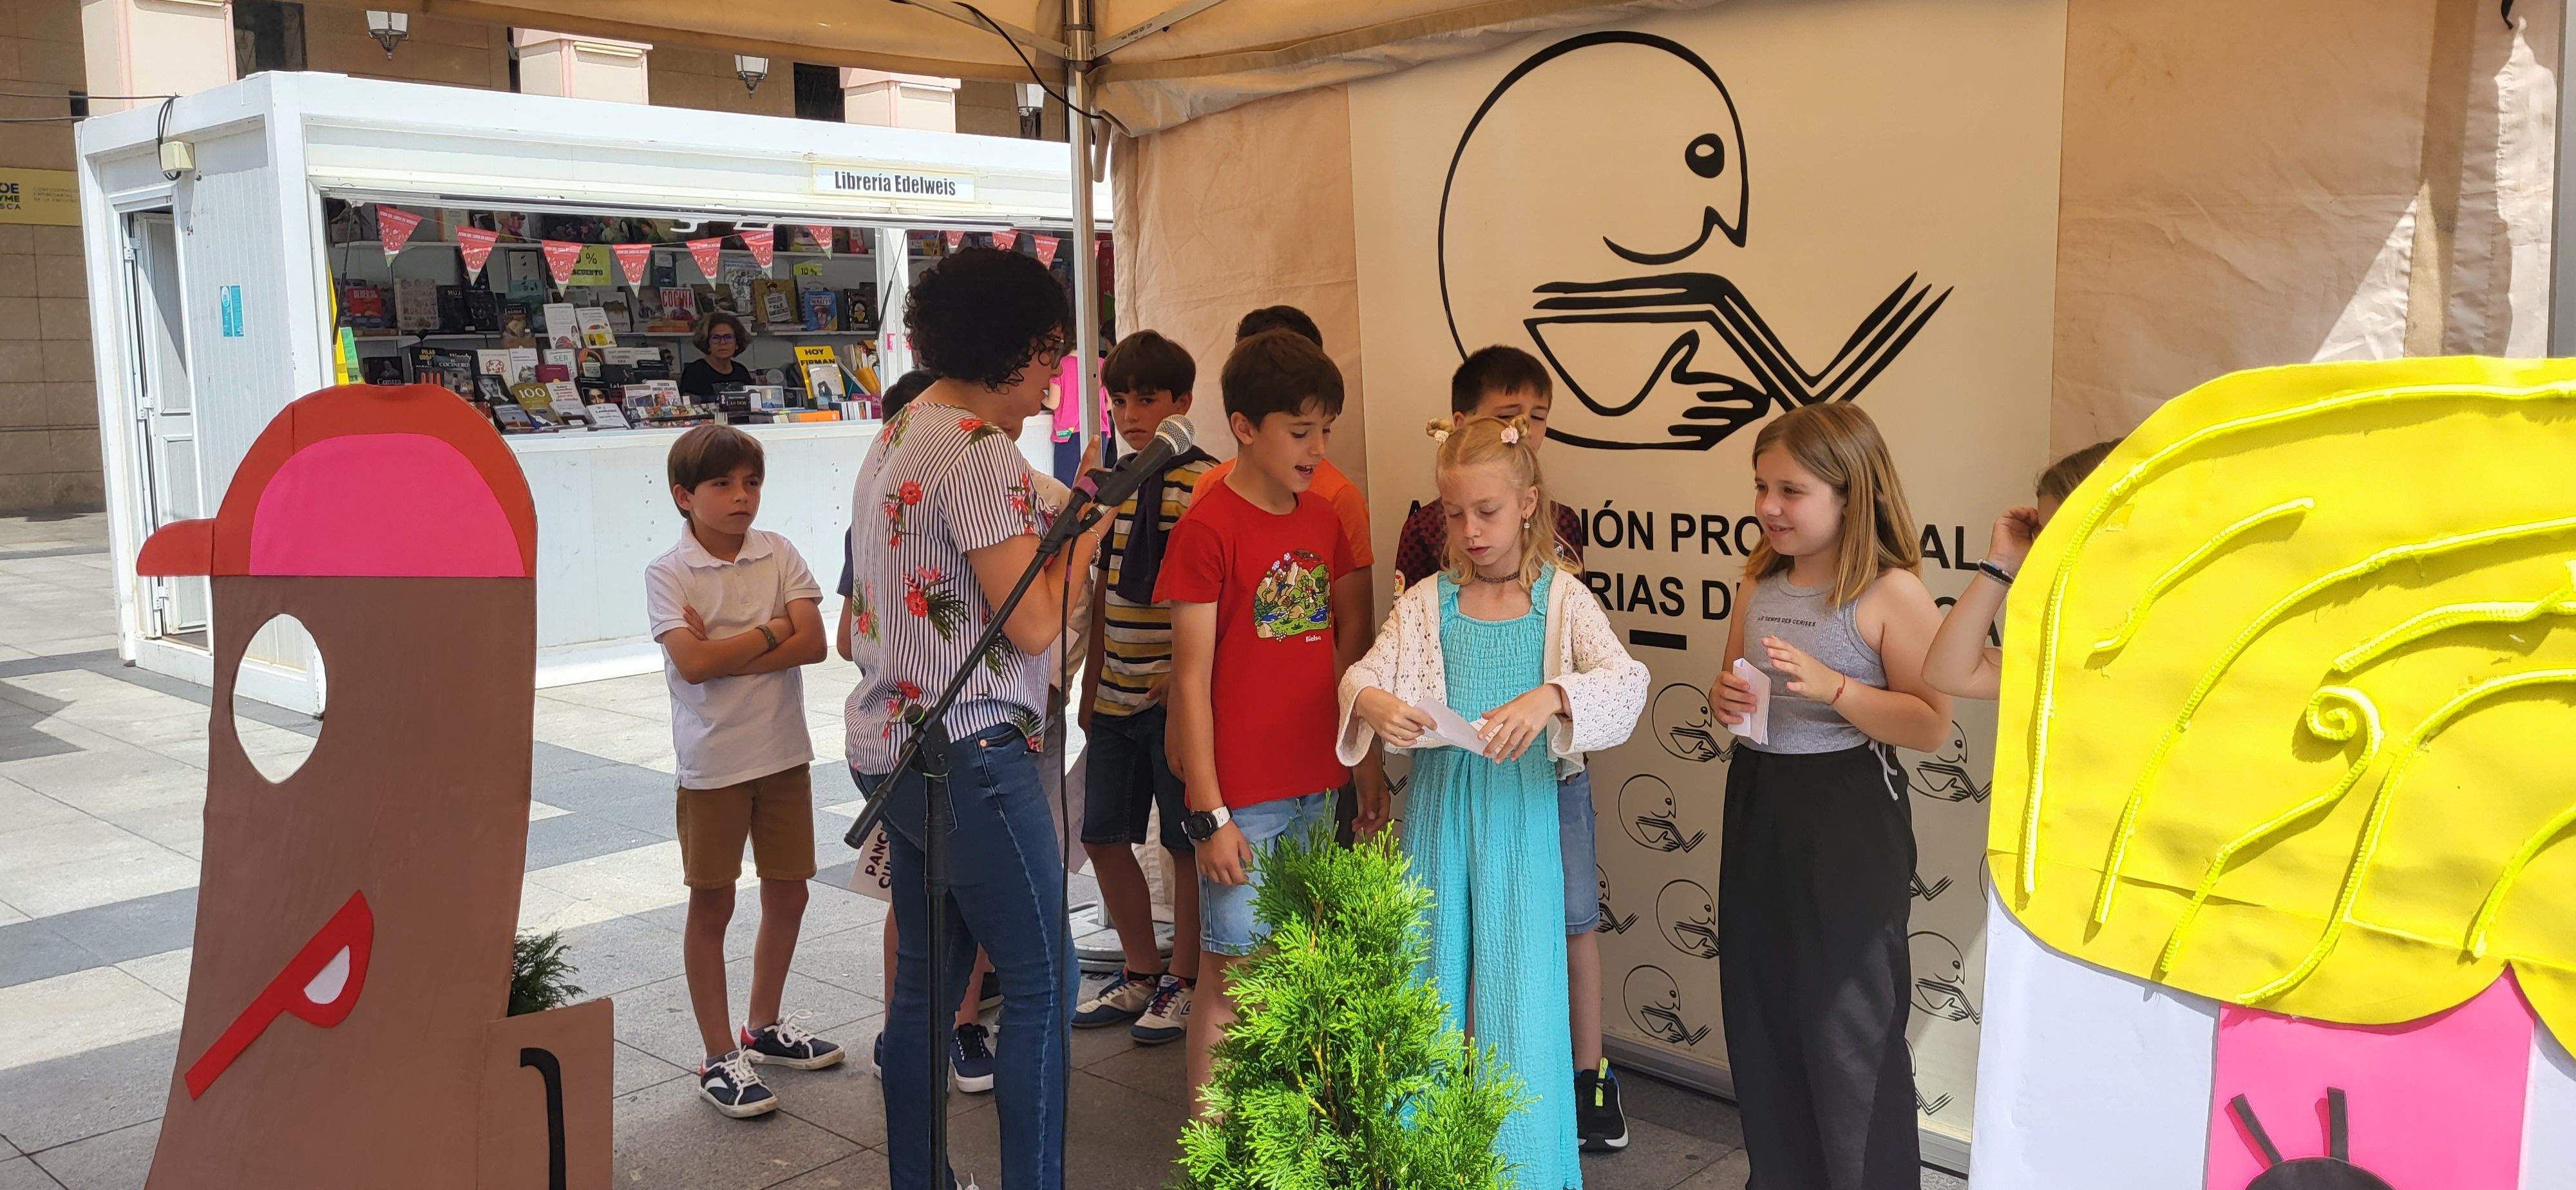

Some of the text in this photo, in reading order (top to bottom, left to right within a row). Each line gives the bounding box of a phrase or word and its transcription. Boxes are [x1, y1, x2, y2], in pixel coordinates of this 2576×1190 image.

[835, 171, 956, 196] Librería Edelweis
[585, 252, 598, 265] %
[800, 267, 809, 276] 10
[518, 388, 546, 399] 100
[1701, 580, 1741, 620] D
[1305, 634, 1321, 643] Bielsa
[865, 828, 889, 876] PANC
